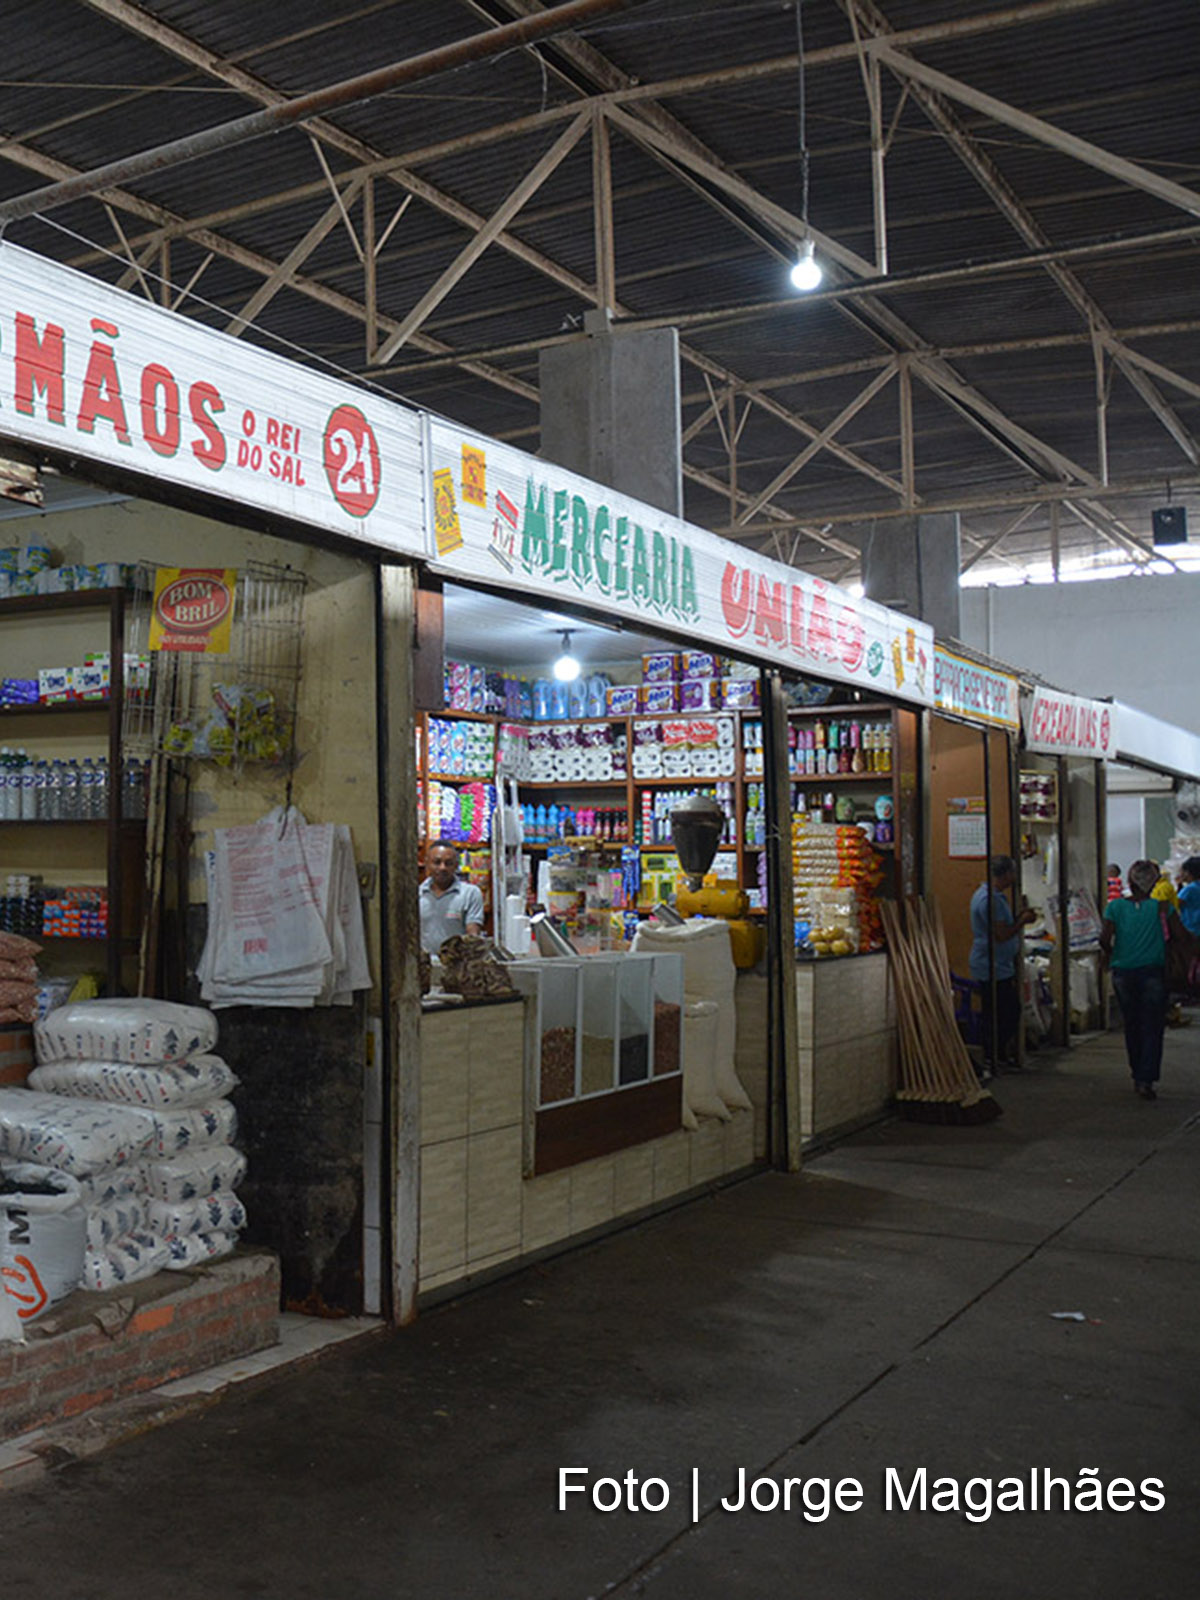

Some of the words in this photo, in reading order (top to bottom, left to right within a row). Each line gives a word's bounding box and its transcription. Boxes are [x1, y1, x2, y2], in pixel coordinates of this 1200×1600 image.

[243, 409, 255, 436] O
[268, 417, 300, 453] REI
[238, 445, 262, 472] DO
[268, 453, 305, 487] SAL
[330, 427, 375, 495] 21
[169, 581, 213, 606] BOM
[520, 474, 698, 618] MERCEARIA
[721, 561, 864, 672] UNIÃO
[175, 601, 219, 621] BRIL
